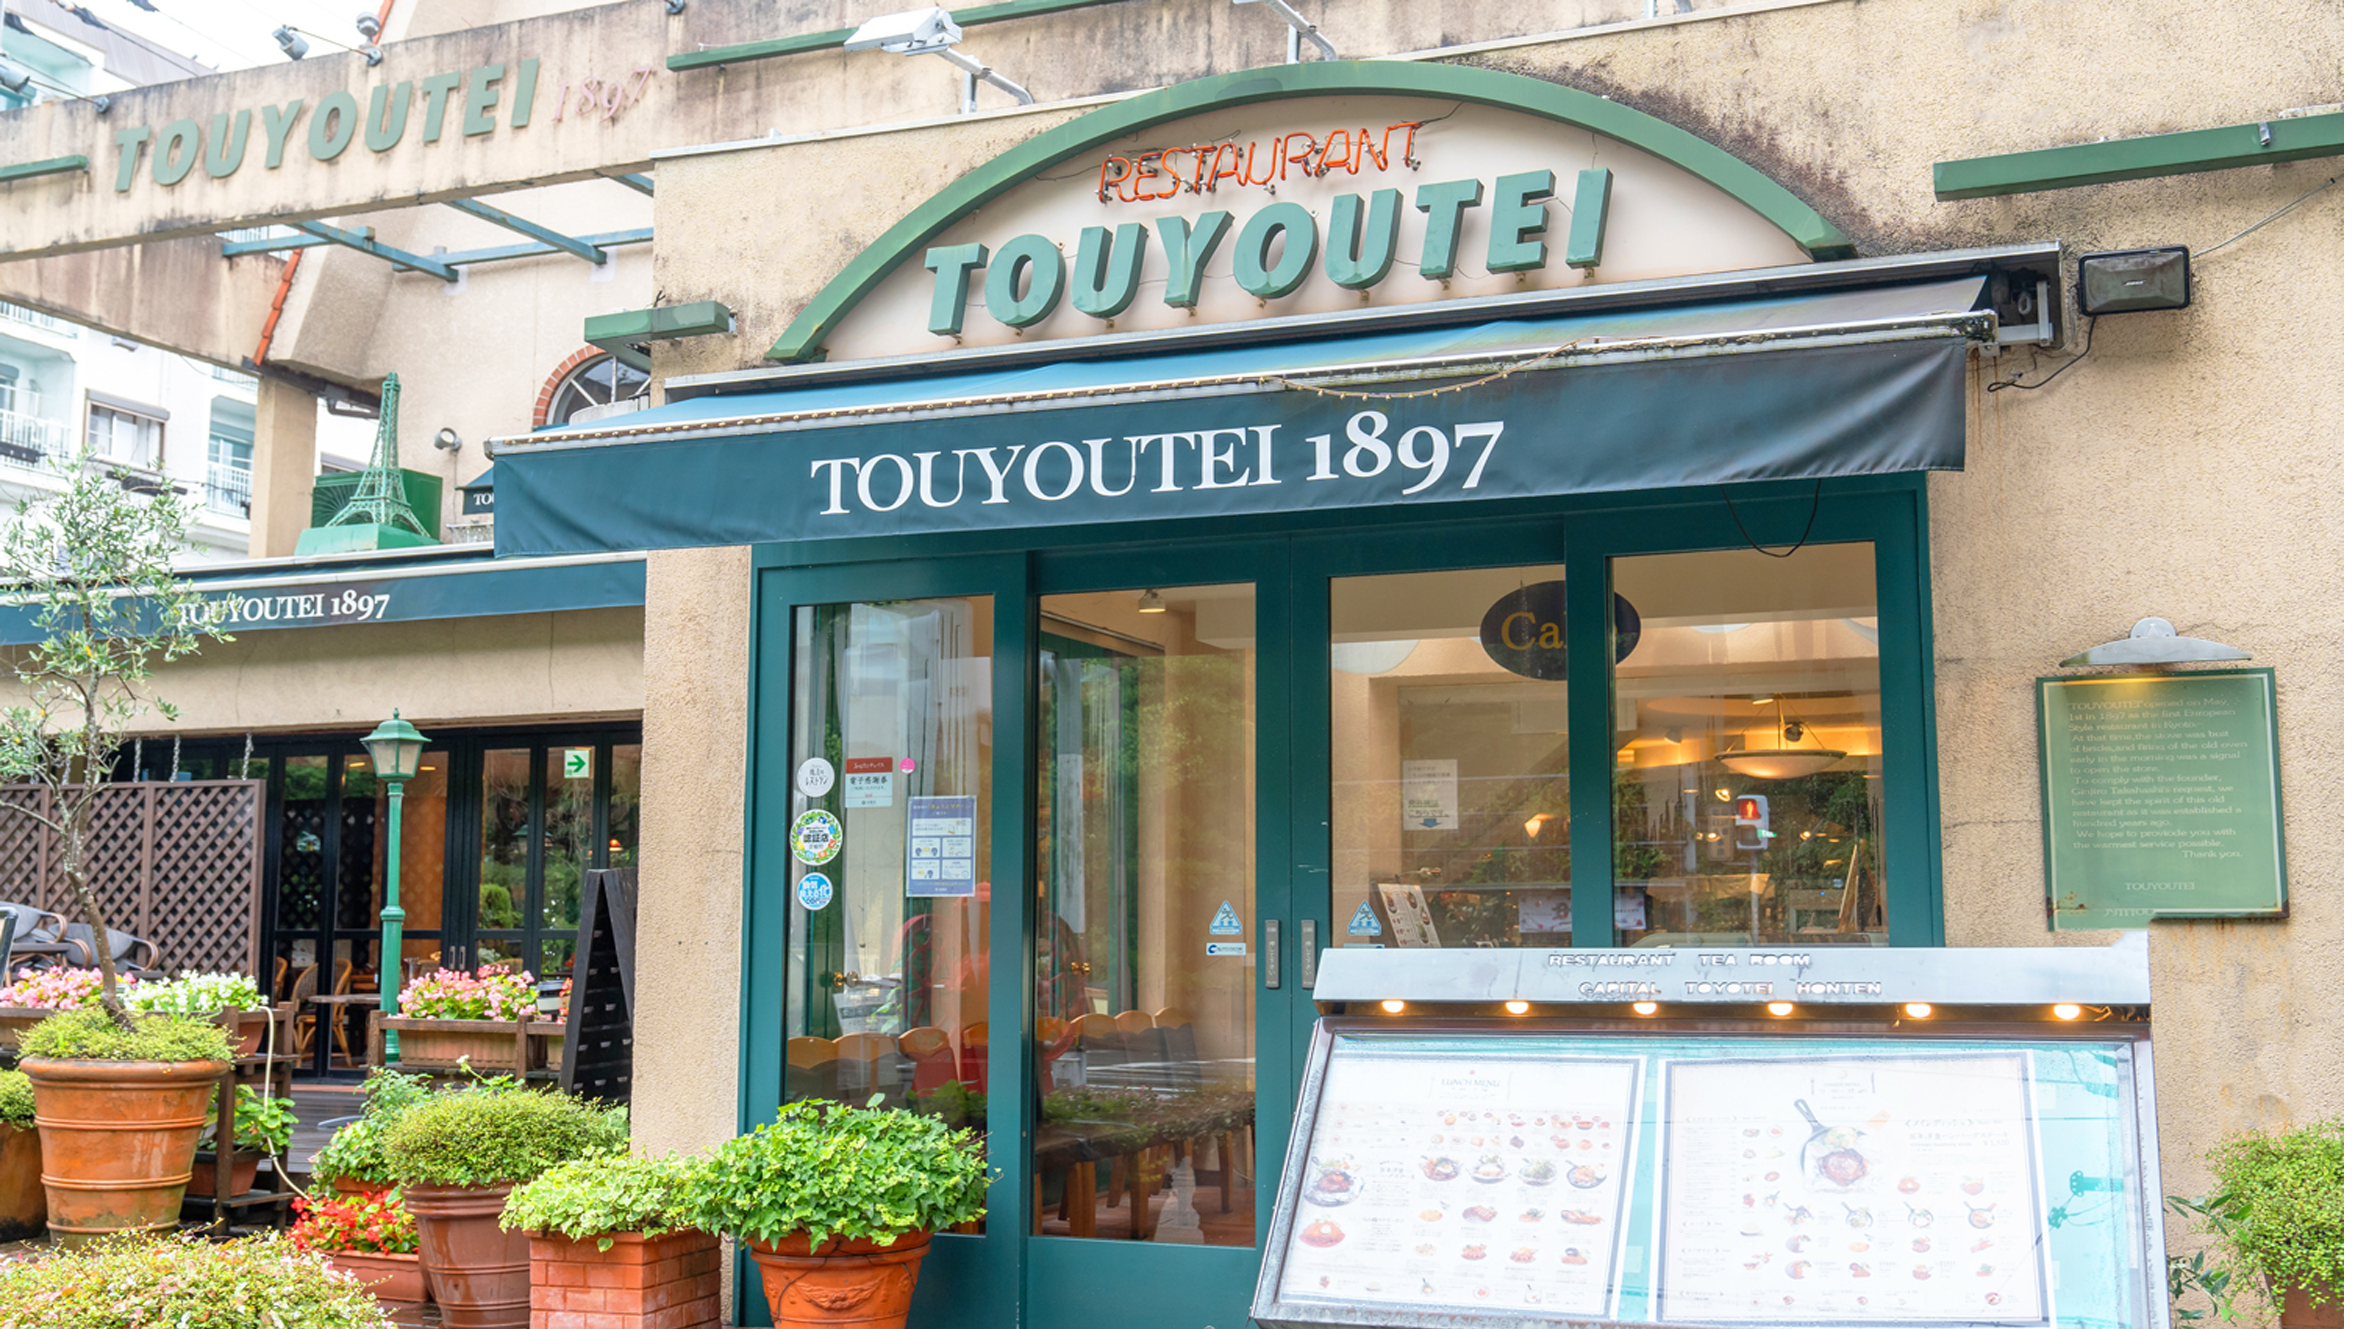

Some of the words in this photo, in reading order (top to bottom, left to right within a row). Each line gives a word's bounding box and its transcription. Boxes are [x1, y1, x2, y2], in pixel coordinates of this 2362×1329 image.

[115, 58, 540, 192] TOUYOUTEI
[551, 66, 652, 124] 1897
[1098, 121, 1423, 203] RESTAURANT
[925, 167, 1613, 336] TOUYOUTEI
[810, 424, 1283, 516] TOUYOUTEI
[1306, 410, 1505, 495] 1897
[473, 492, 494, 506] TO
[331, 589, 390, 621] 1897
[1549, 953, 1676, 967] RESTAURANT
[1699, 954, 1737, 966] TEA
[1749, 953, 1811, 966] ROOM
[1579, 981, 1662, 994] CAPITAL
[1684, 981, 1774, 995] TOYOTEI
[1796, 981, 1882, 995] HONTEN
